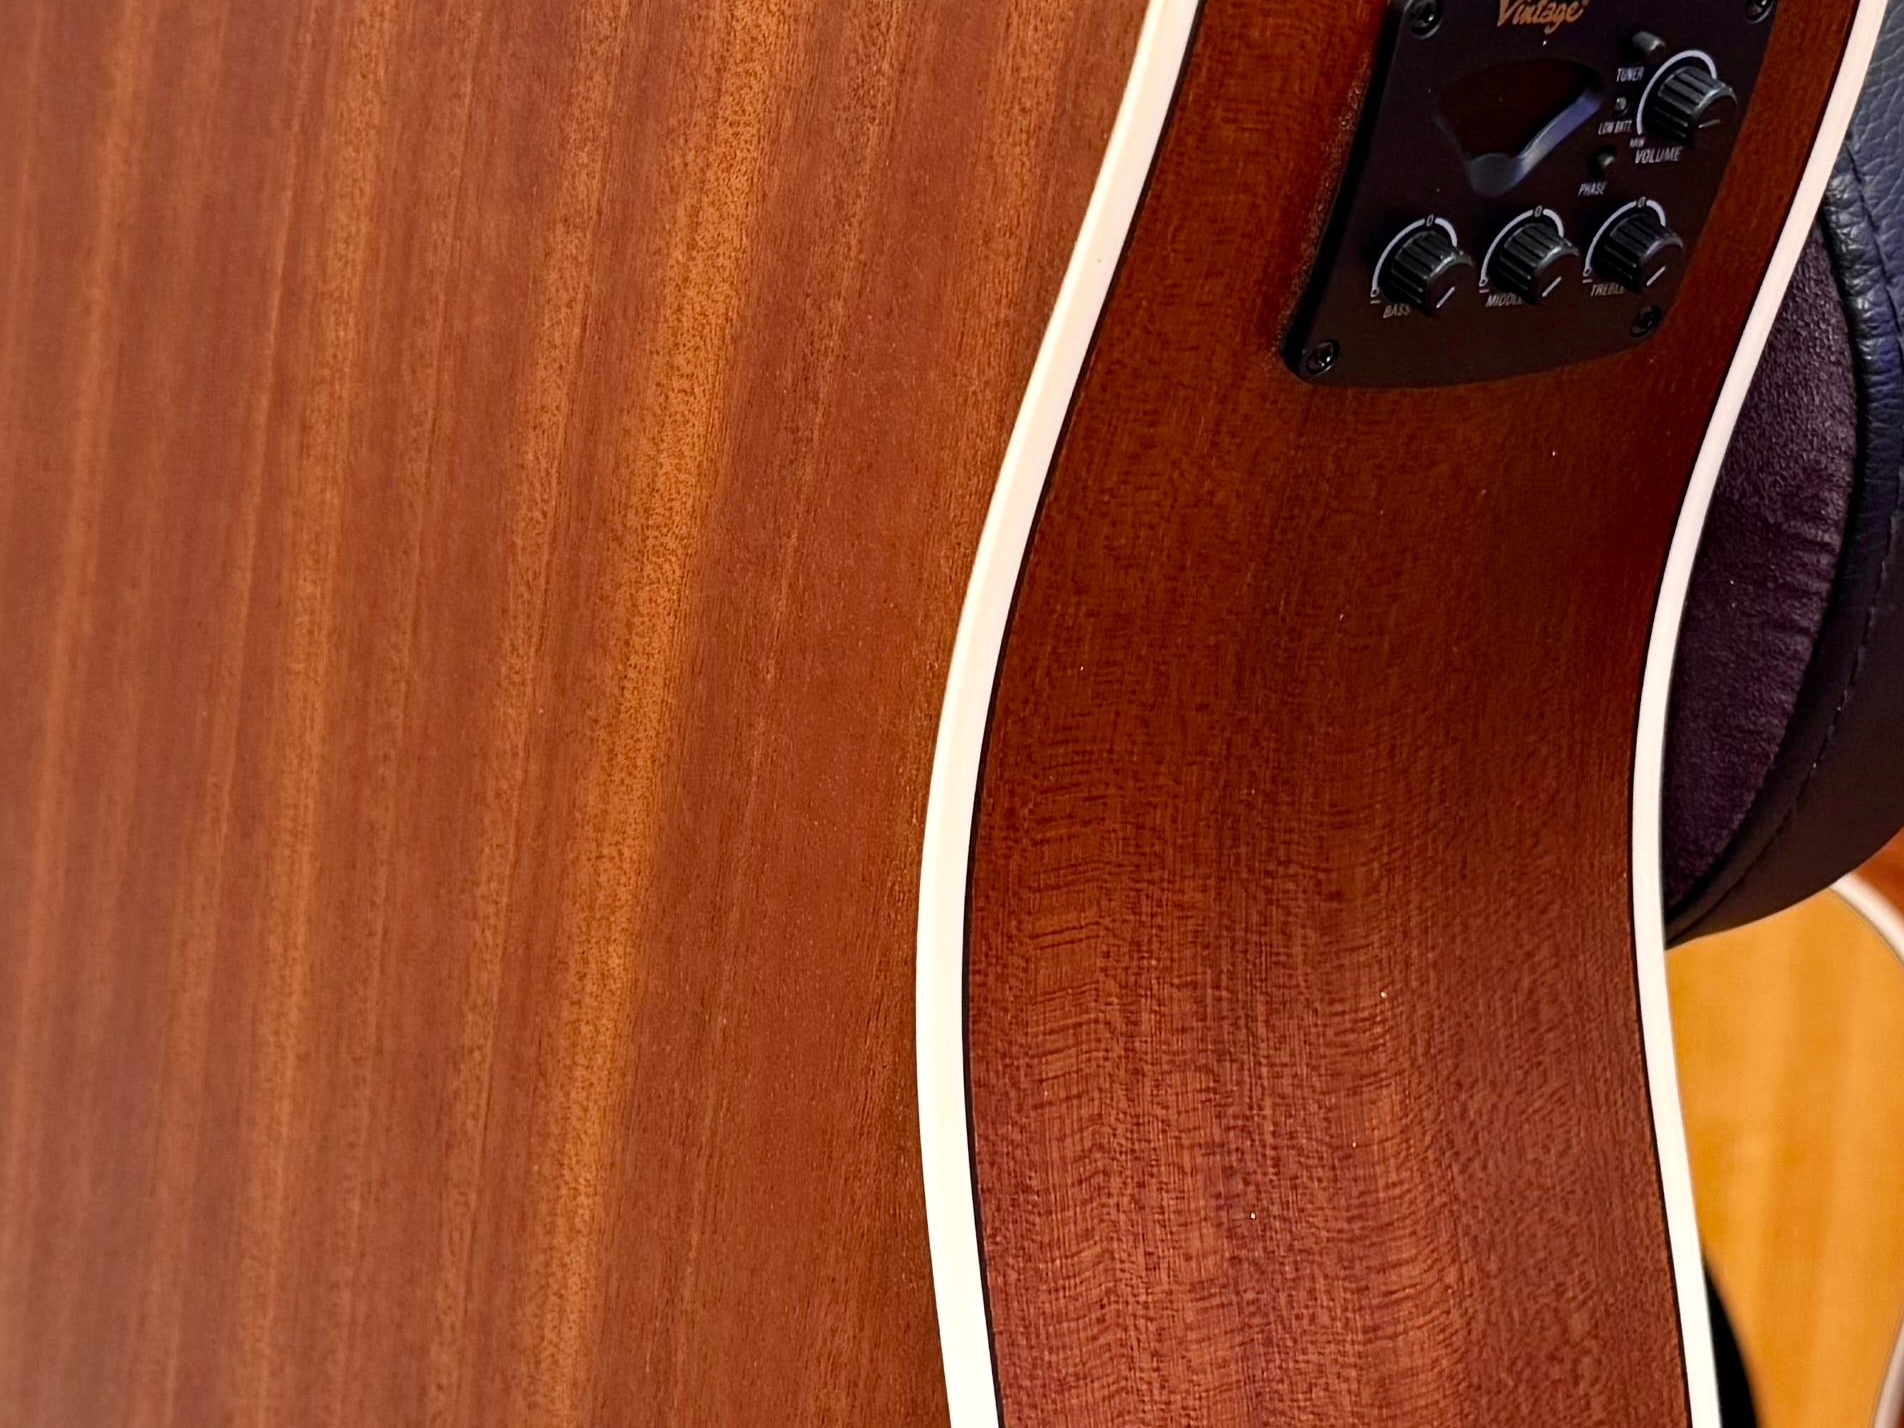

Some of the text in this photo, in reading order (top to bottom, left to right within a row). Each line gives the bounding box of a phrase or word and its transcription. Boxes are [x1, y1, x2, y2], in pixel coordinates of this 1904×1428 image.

[1635, 146, 1682, 164] VOLUME
[1578, 181, 1607, 196] PHASE
[1383, 303, 1411, 319] BASS
